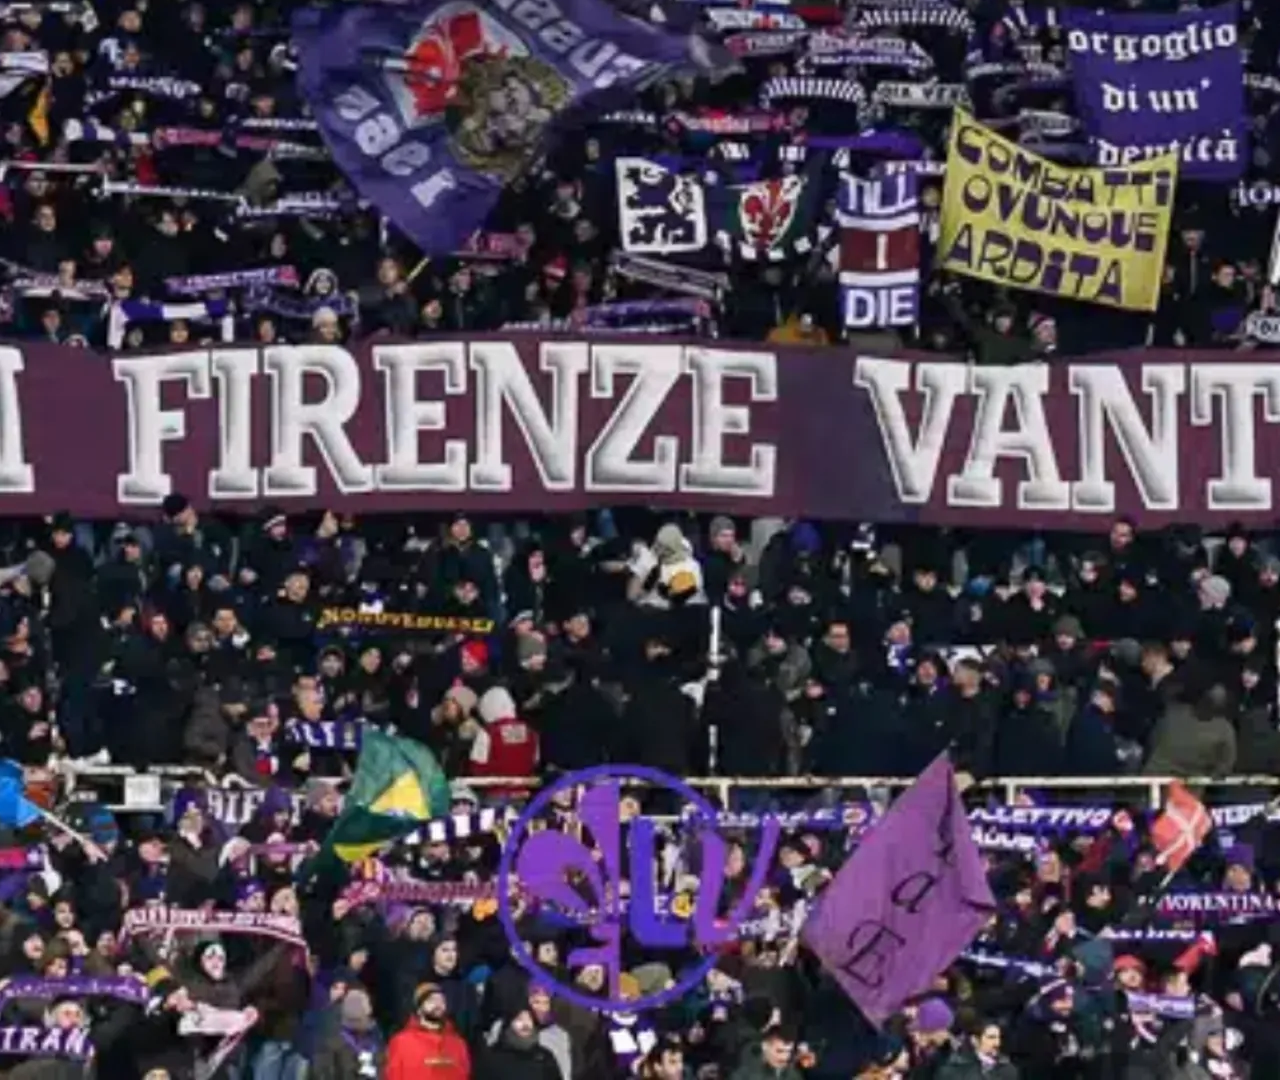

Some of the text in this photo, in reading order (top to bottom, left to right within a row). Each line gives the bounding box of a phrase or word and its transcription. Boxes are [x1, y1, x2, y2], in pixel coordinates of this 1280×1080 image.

[1068, 21, 1238, 62] orgoglio
[1100, 82, 1140, 112] di
[838, 171, 918, 215] TILL
[845, 287, 915, 328] DIE
[111, 341, 778, 505] FIRENZE
